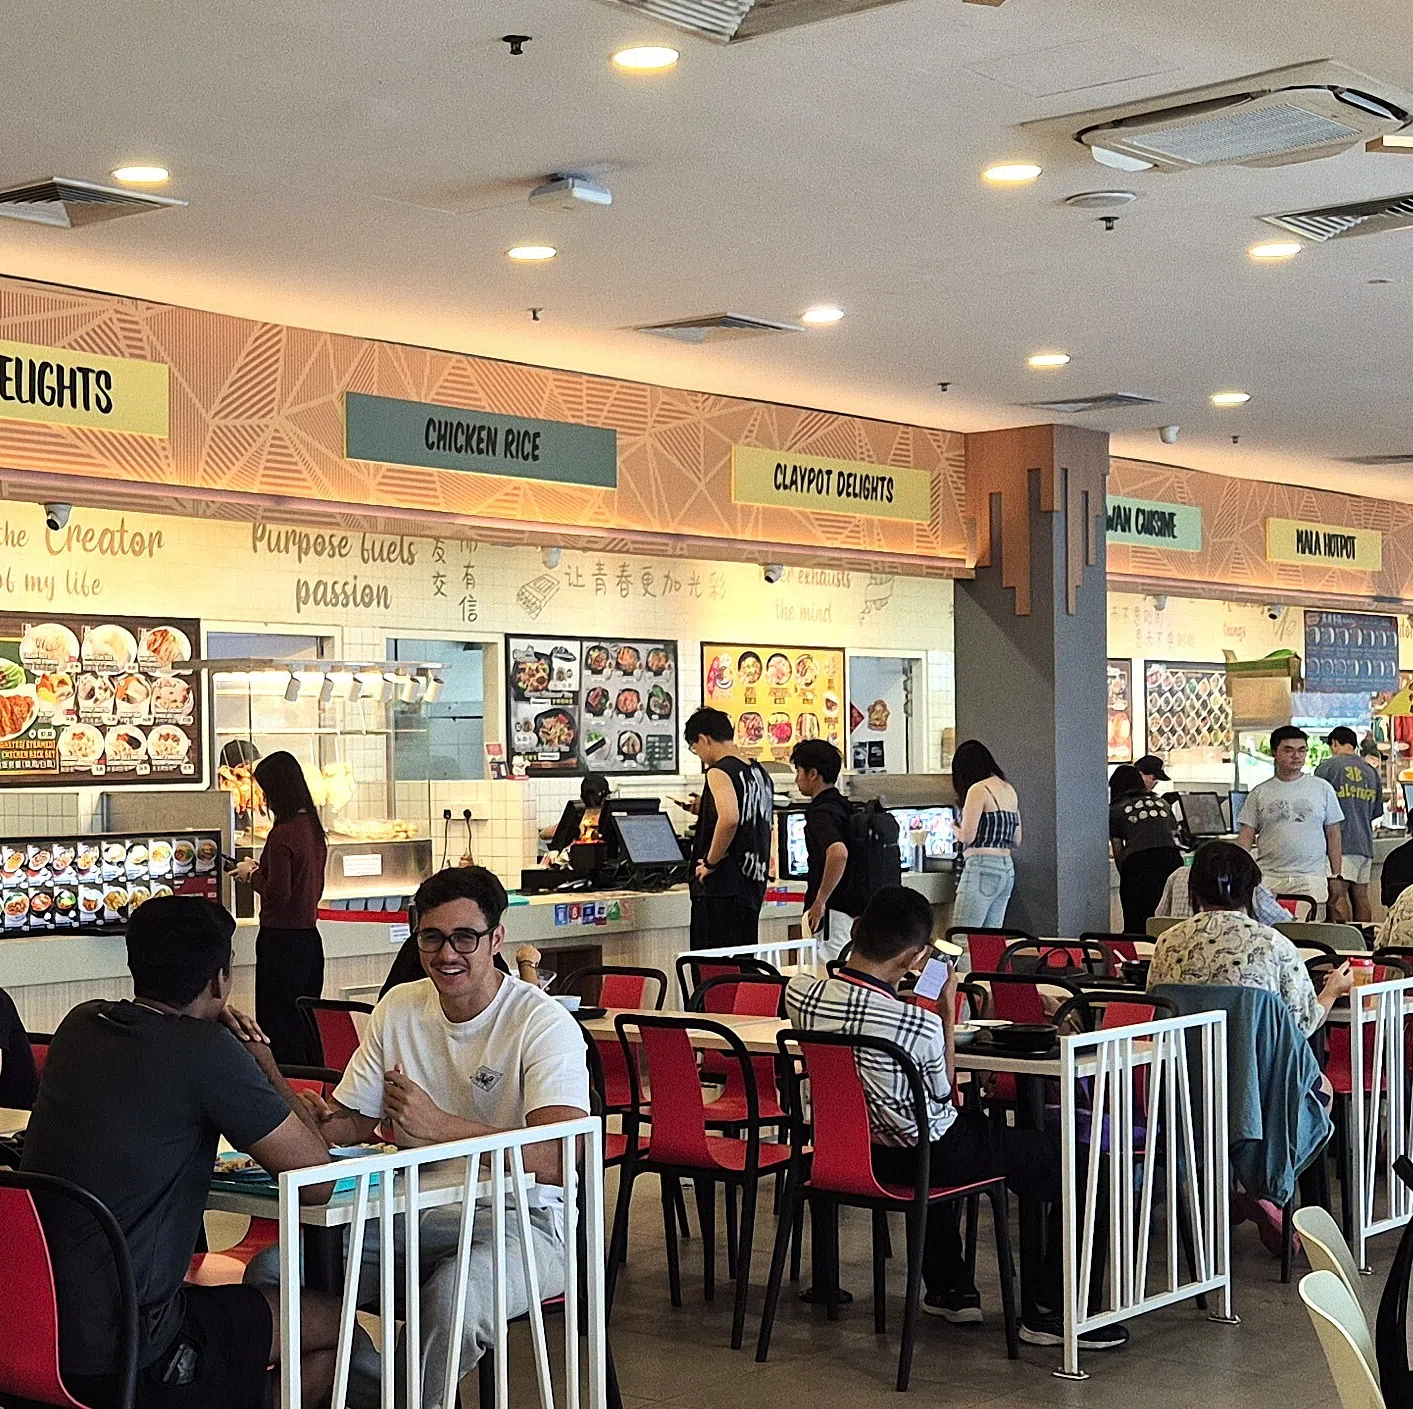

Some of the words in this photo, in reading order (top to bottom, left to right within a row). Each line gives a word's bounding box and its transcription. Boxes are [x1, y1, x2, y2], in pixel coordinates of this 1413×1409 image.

[424, 417, 498, 457] CHICKEN
[504, 428, 541, 462] RICE
[774, 462, 833, 496] CLAYPOT
[836, 470, 894, 503] DELIGHTS
[44, 516, 166, 558] Creator
[1135, 507, 1178, 539] CUISINE
[1296, 523, 1322, 556] MALA
[1323, 531, 1357, 560] HOTPOT
[252, 522, 352, 564] Purpose
[361, 531, 419, 566] fuels
[24, 572, 56, 602] my
[65, 568, 104, 597] life
[295, 574, 393, 614] passion
[564, 560, 727, 601] 让青春更加光彩
[799, 602, 833, 623] mind
